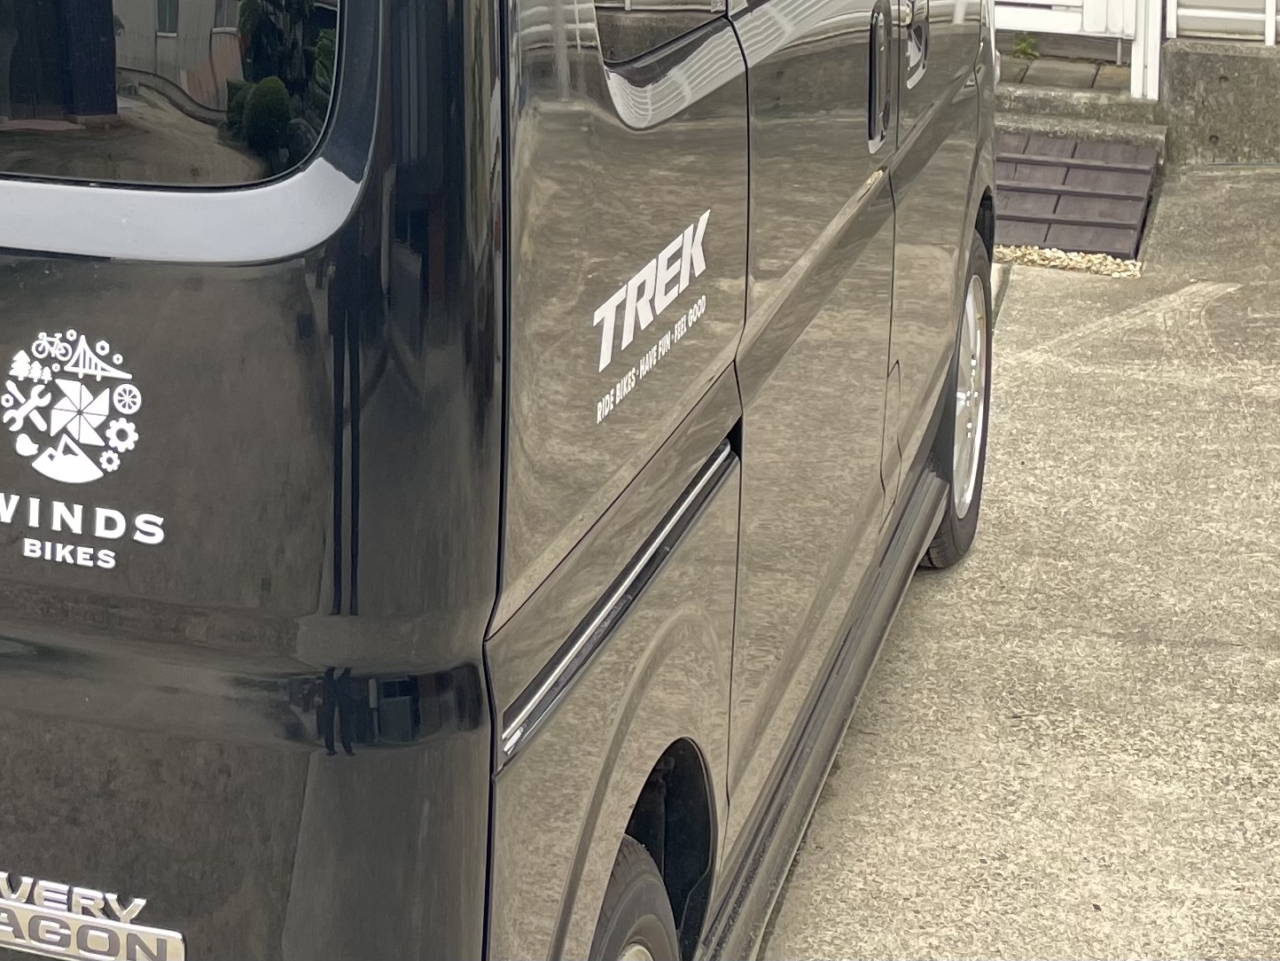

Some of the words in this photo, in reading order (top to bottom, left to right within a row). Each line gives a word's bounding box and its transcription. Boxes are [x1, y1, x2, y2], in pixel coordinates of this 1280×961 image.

[592, 209, 711, 373] TREK
[596, 388, 615, 424] RIDE
[688, 294, 706, 328] GOOD
[23, 537, 117, 570] BIKES
